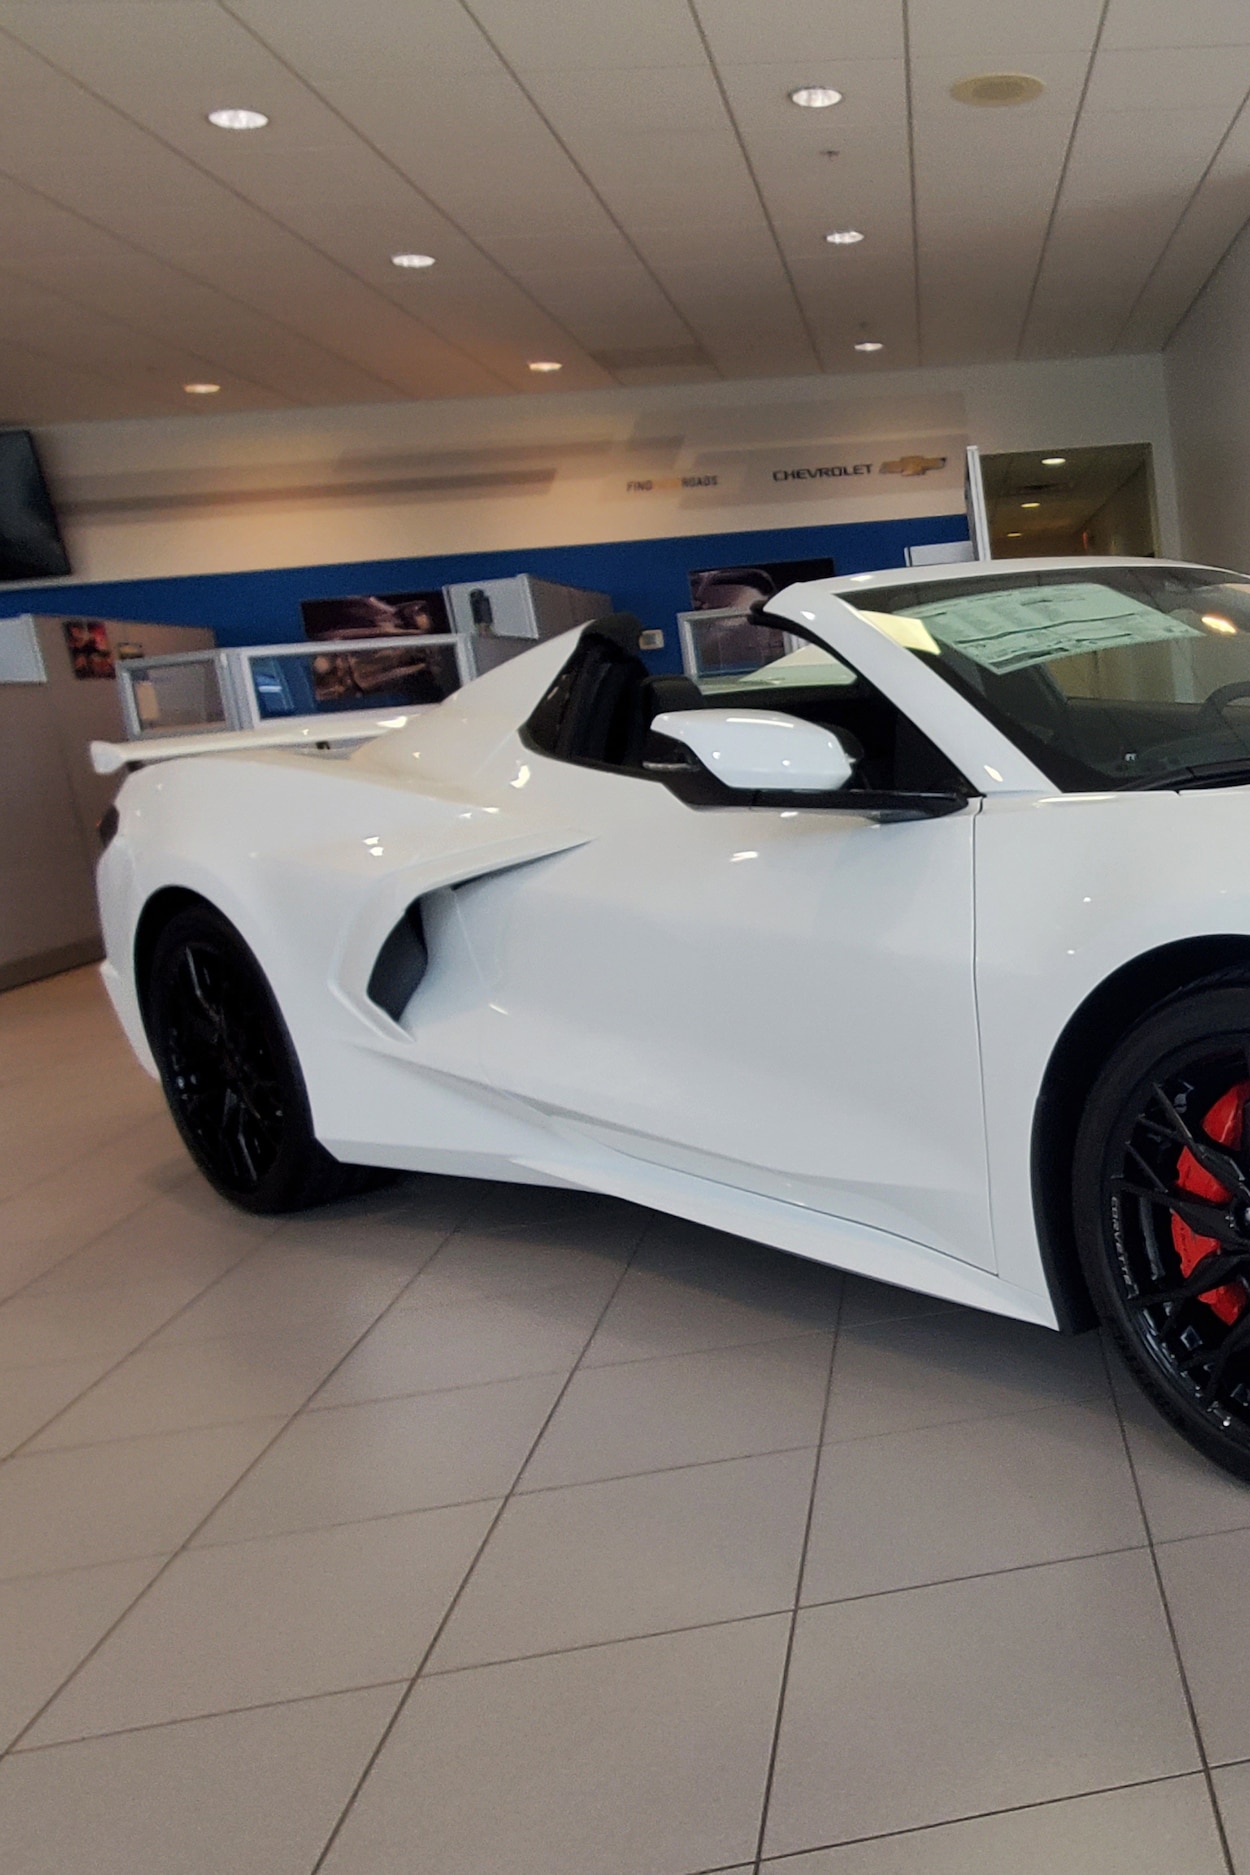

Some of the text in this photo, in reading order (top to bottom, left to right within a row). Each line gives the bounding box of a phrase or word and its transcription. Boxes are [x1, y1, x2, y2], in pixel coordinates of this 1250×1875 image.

[772, 464, 873, 482] CHEVROLET
[626, 481, 653, 492] FIND
[681, 475, 718, 488] ROADS
[1110, 1196, 1133, 1285] CORVETTE
